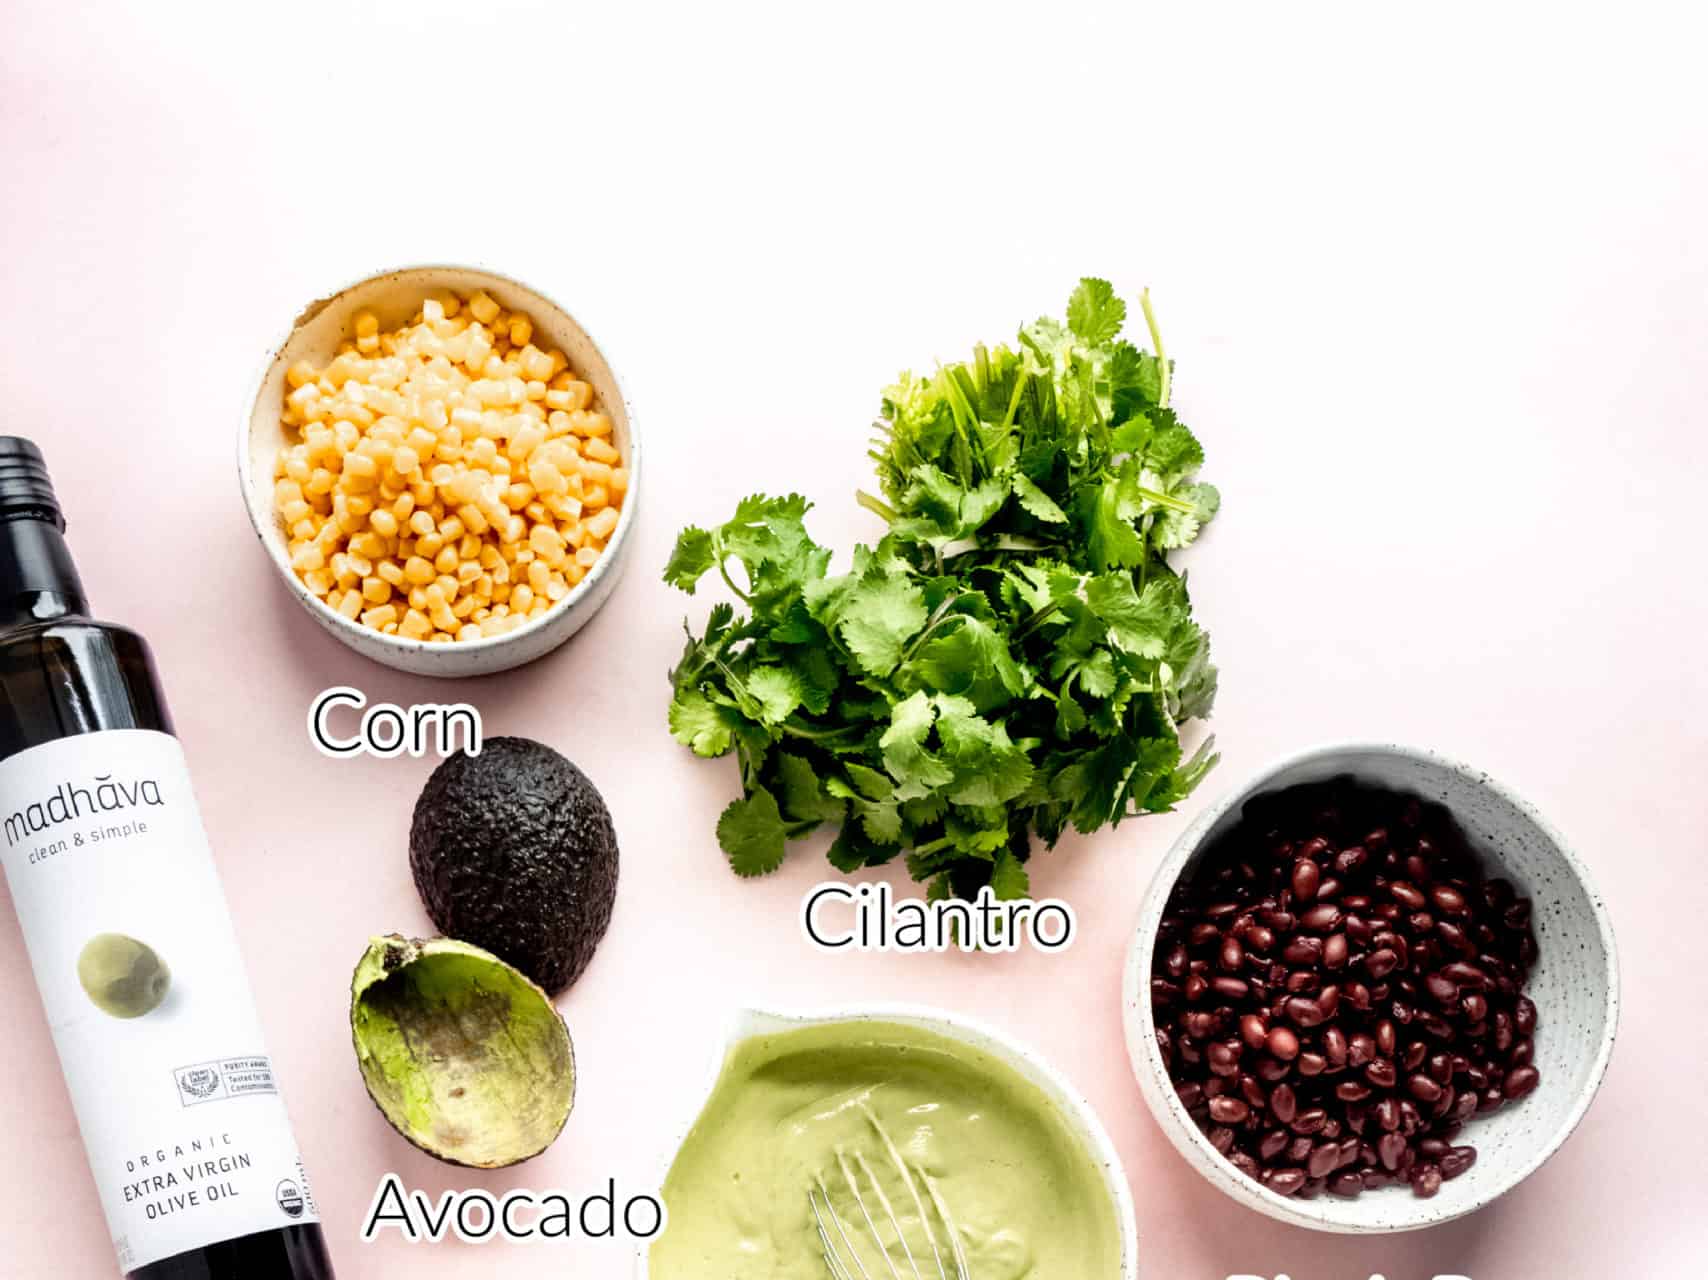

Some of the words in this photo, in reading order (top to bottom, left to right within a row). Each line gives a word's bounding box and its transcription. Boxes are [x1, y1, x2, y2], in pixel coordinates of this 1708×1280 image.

[28, 840, 68, 865] clean
[73, 832, 85, 848] &
[90, 820, 149, 843] simple
[126, 1133, 232, 1173] ORGANIC
[122, 1171, 179, 1203] EXTRA
[182, 1151, 251, 1183] VIRGIN
[144, 1190, 201, 1220] OLIVE
[206, 1182, 239, 1202] OIL
